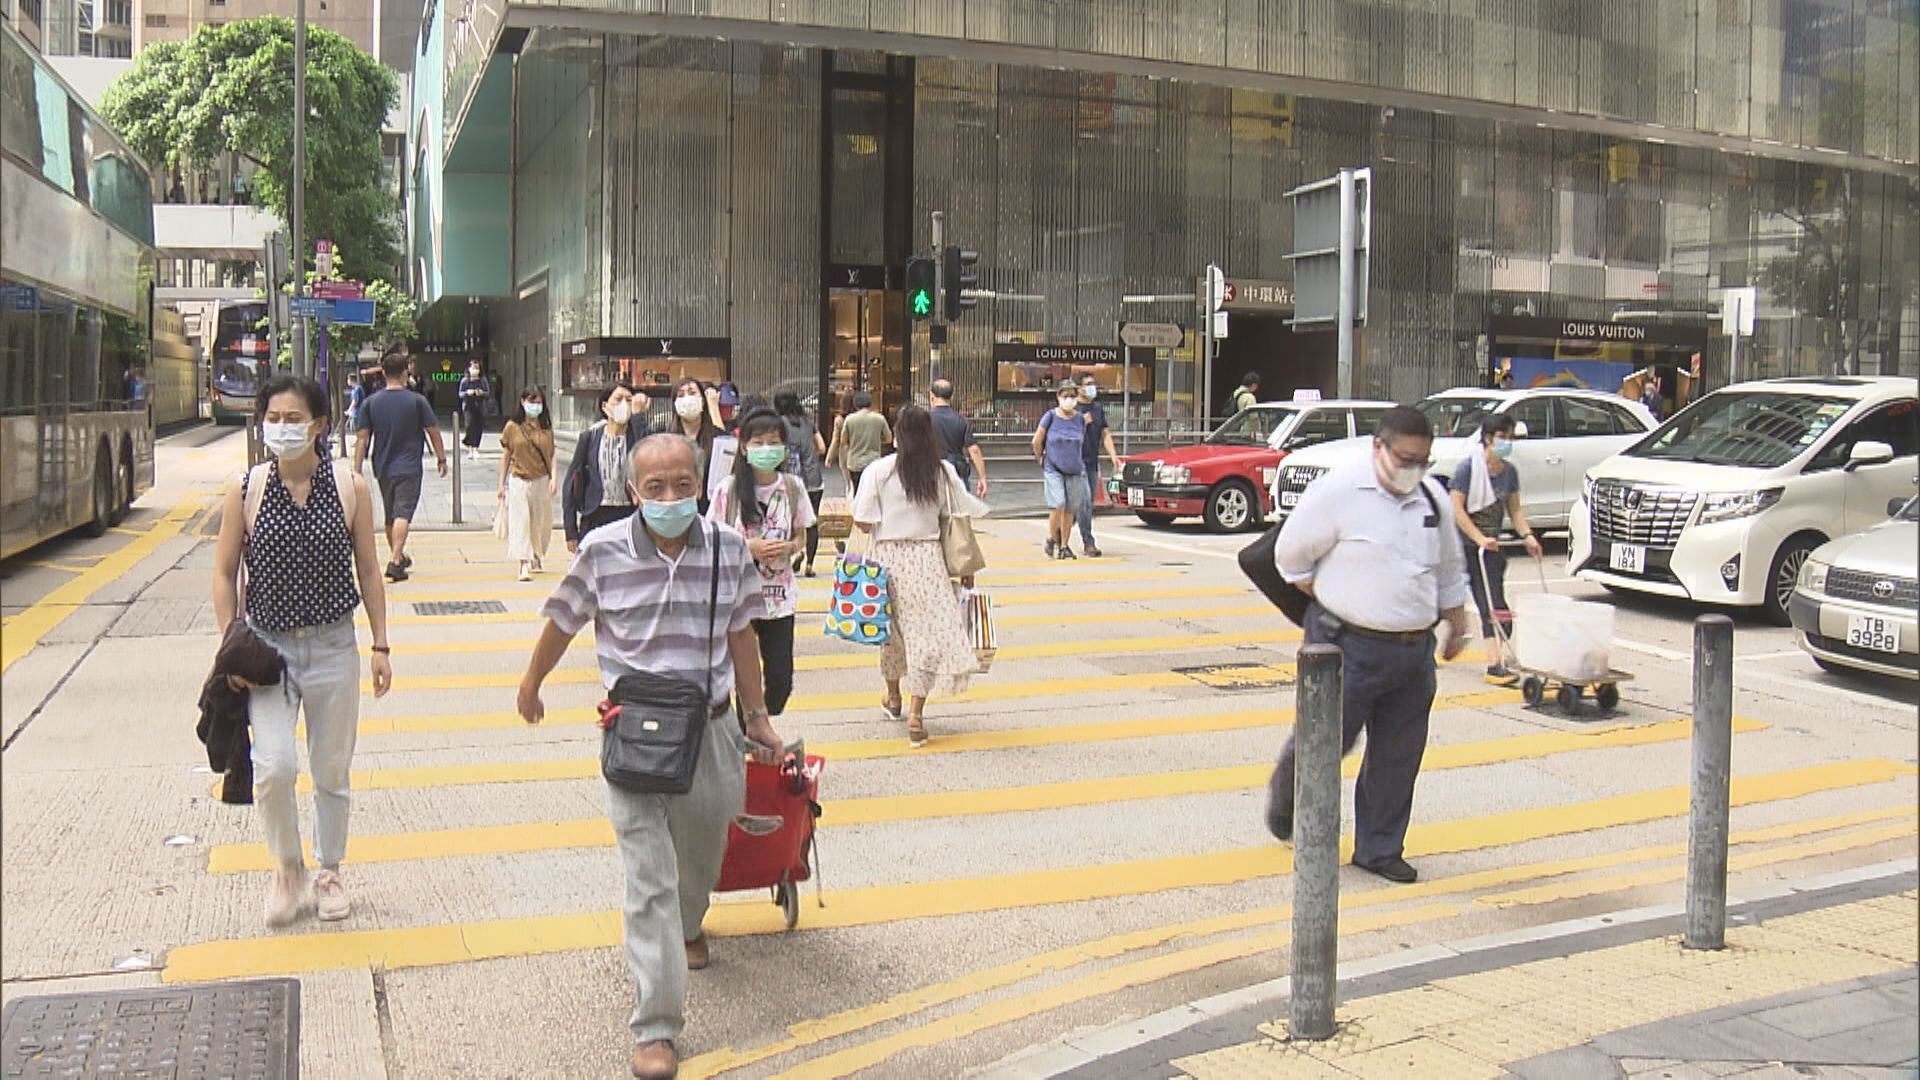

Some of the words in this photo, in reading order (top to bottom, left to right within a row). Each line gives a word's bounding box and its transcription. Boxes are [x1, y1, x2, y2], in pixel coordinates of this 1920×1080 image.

[1243, 285, 1288, 304] 中環站
[1562, 322, 1596, 337] LOUIS
[1598, 325, 1646, 339] VUITTON
[1035, 348, 1068, 359] LOUIS
[1071, 349, 1117, 360] VUITTON
[1622, 545, 1636, 558] VN
[1617, 556, 1636, 570] 184
[1864, 616, 1884, 632] TB
[1850, 629, 1895, 650] 3928
